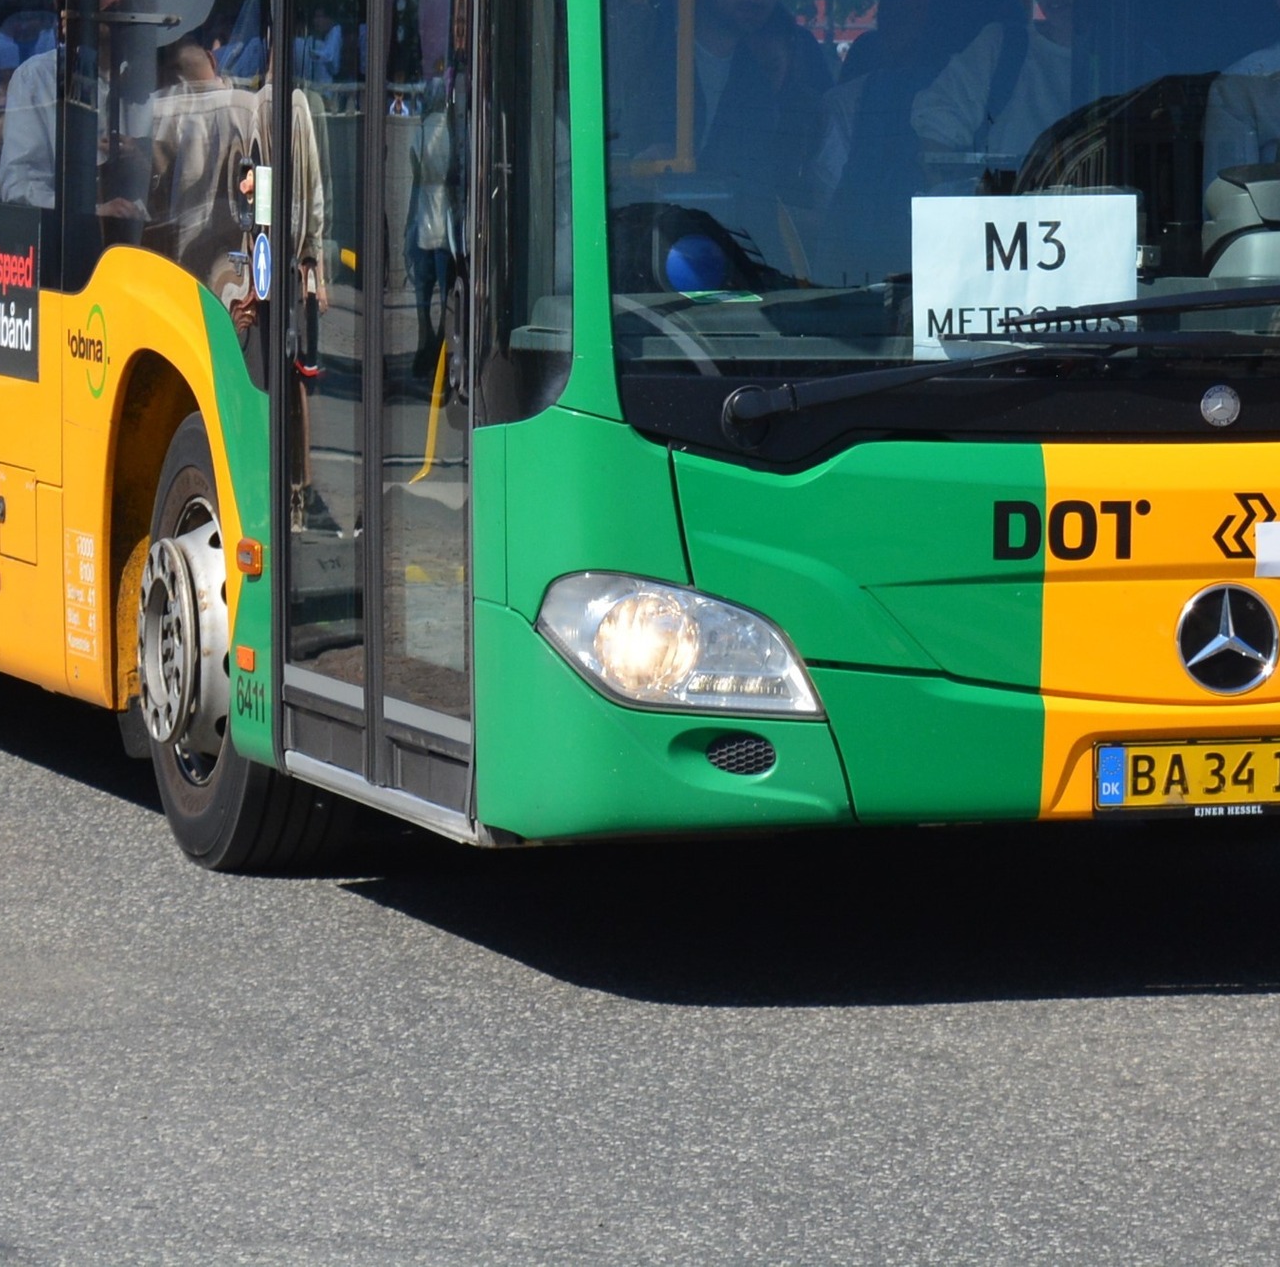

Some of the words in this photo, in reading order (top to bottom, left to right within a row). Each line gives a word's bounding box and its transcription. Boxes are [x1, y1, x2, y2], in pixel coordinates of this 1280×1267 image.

[984, 220, 1067, 272] M3
[993, 499, 1151, 561] DOT
[236, 675, 265, 723] 6411
[1102, 782, 1120, 795] DK
[1131, 753, 1190, 796] BA
[1202, 750, 1255, 795] 34
[1194, 807, 1225, 817] EJNER
[1227, 805, 1263, 816] HESSEL
